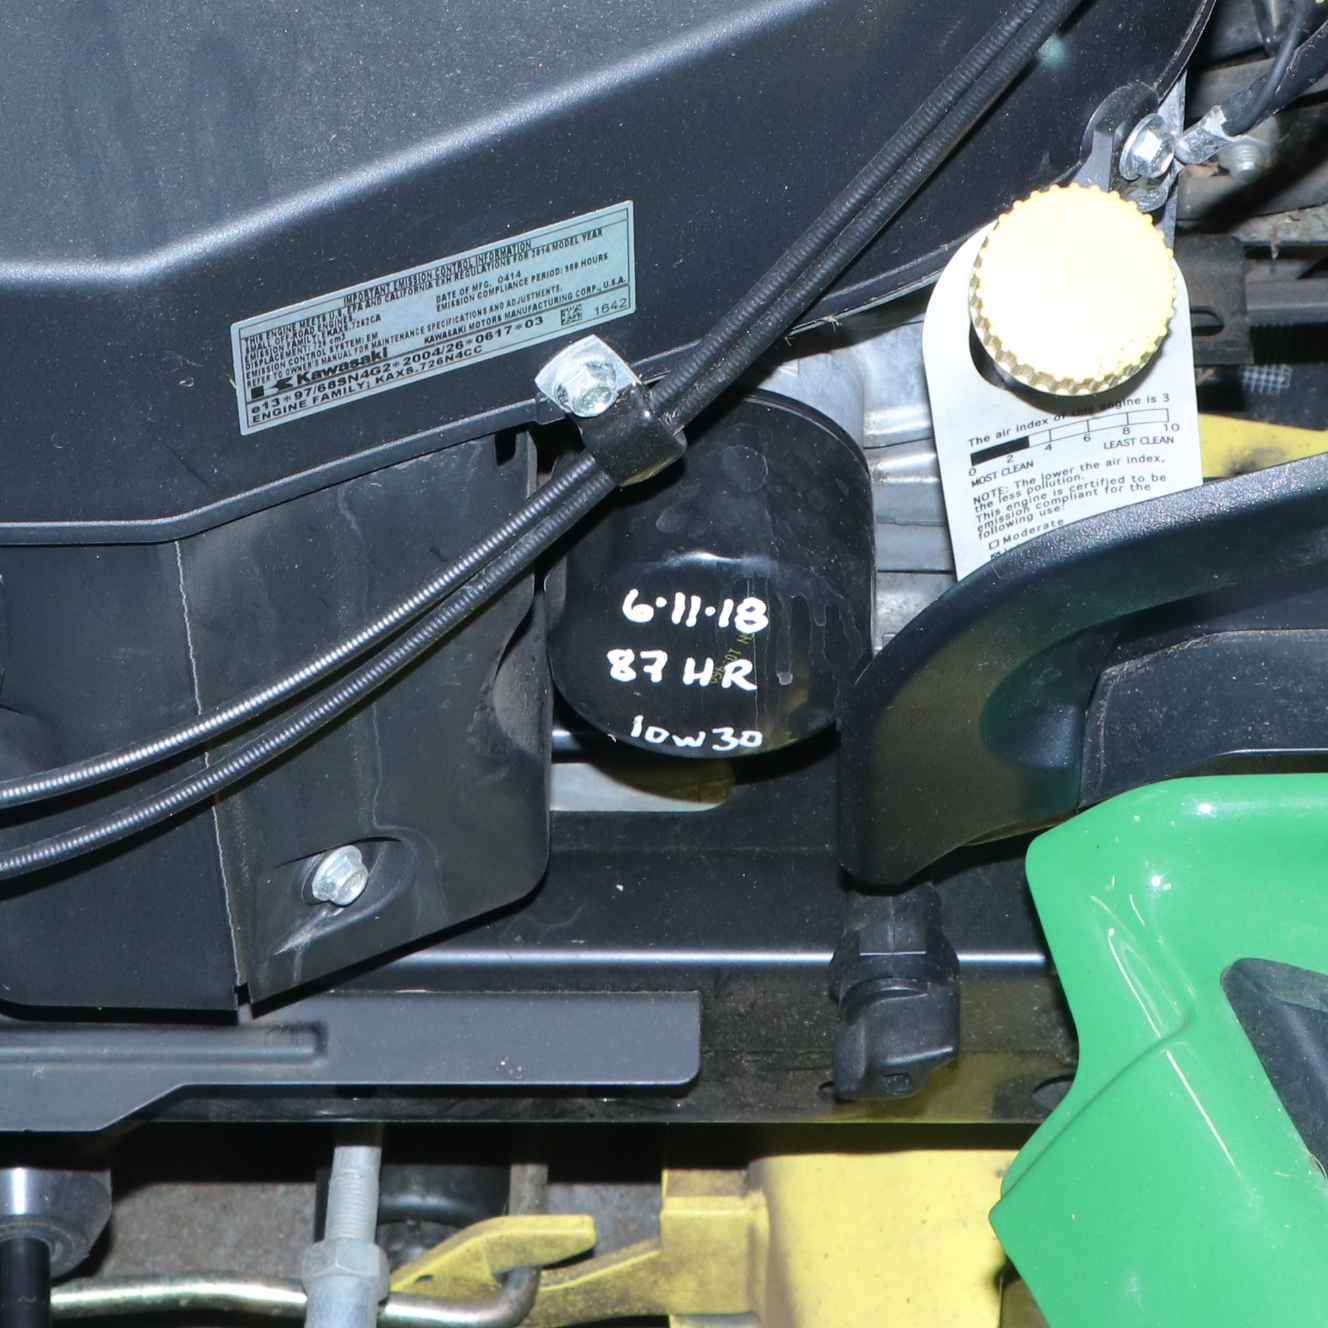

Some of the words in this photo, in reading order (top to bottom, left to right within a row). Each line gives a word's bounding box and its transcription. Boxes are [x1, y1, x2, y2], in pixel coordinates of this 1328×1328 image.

[343, 282, 390, 306] IMPORTANT
[393, 270, 432, 290] EMISSION
[434, 257, 472, 278] CONTROL
[475, 239, 531, 265] INFORMATION
[435, 290, 456, 303] DATE
[459, 286, 468, 296] OF
[497, 270, 521, 283] 0414
[436, 294, 474, 312] EMISSION
[477, 277, 527, 299] COMPLIANCE
[531, 267, 562, 282] PERIOD:
[581, 252, 607, 267] HOURS
[424, 325, 466, 343] KAWASAKI
[468, 314, 501, 329] MOTORS
[504, 292, 572, 319] MANUFACTURING
[594, 297, 626, 315] 1642
[246, 361, 285, 379] EMISSION
[288, 348, 326, 366] CONTROL
[329, 337, 364, 353] SYSTEM:
[366, 331, 377, 342] EM
[296, 347, 387, 384] Kawasaki
[252, 399, 306, 423] ENGINE
[967, 436, 990, 447] The
[995, 428, 1011, 439] air
[1016, 418, 1048, 432] index
[1147, 395, 1157, 403] is
[1163, 393, 1170, 402] 3
[1007, 455, 1014, 463] 2
[1045, 443, 1052, 452] 4
[1083, 434, 1091, 442] 6
[1122, 426, 1130, 435] 8
[1163, 423, 1180, 432] 10
[1104, 437, 1137, 450] LEAST
[1139, 436, 1174, 445] CLEAN
[971, 471, 998, 488] MOST
[1001, 460, 1034, 477] CLEAN
[973, 486, 1009, 505] NOTE:
[1014, 477, 1036, 489] The
[1041, 468, 1074, 481] lower
[1080, 462, 1100, 472] the
[1106, 458, 1121, 467] air
[1127, 454, 1165, 464] index,
[975, 501, 993, 513] the
[998, 491, 1022, 504] less
[1026, 474, 1085, 496] pollution.
[975, 509, 1001, 523] This
[1006, 493, 1047, 511] engine
[1053, 488, 1063, 497] is
[1069, 475, 1125, 492] certified
[1132, 475, 1145, 483] to
[1151, 473, 1166, 482] be
[977, 506, 1030, 533] emission
[1035, 489, 1098, 510] compliant
[1105, 486, 1123, 494] for
[1130, 483, 1151, 491] the
[978, 513, 1033, 540] following
[1003, 519, 1064, 544] Moderate
[607, 649, 668, 683] 87
[682, 657, 758, 691] HR
